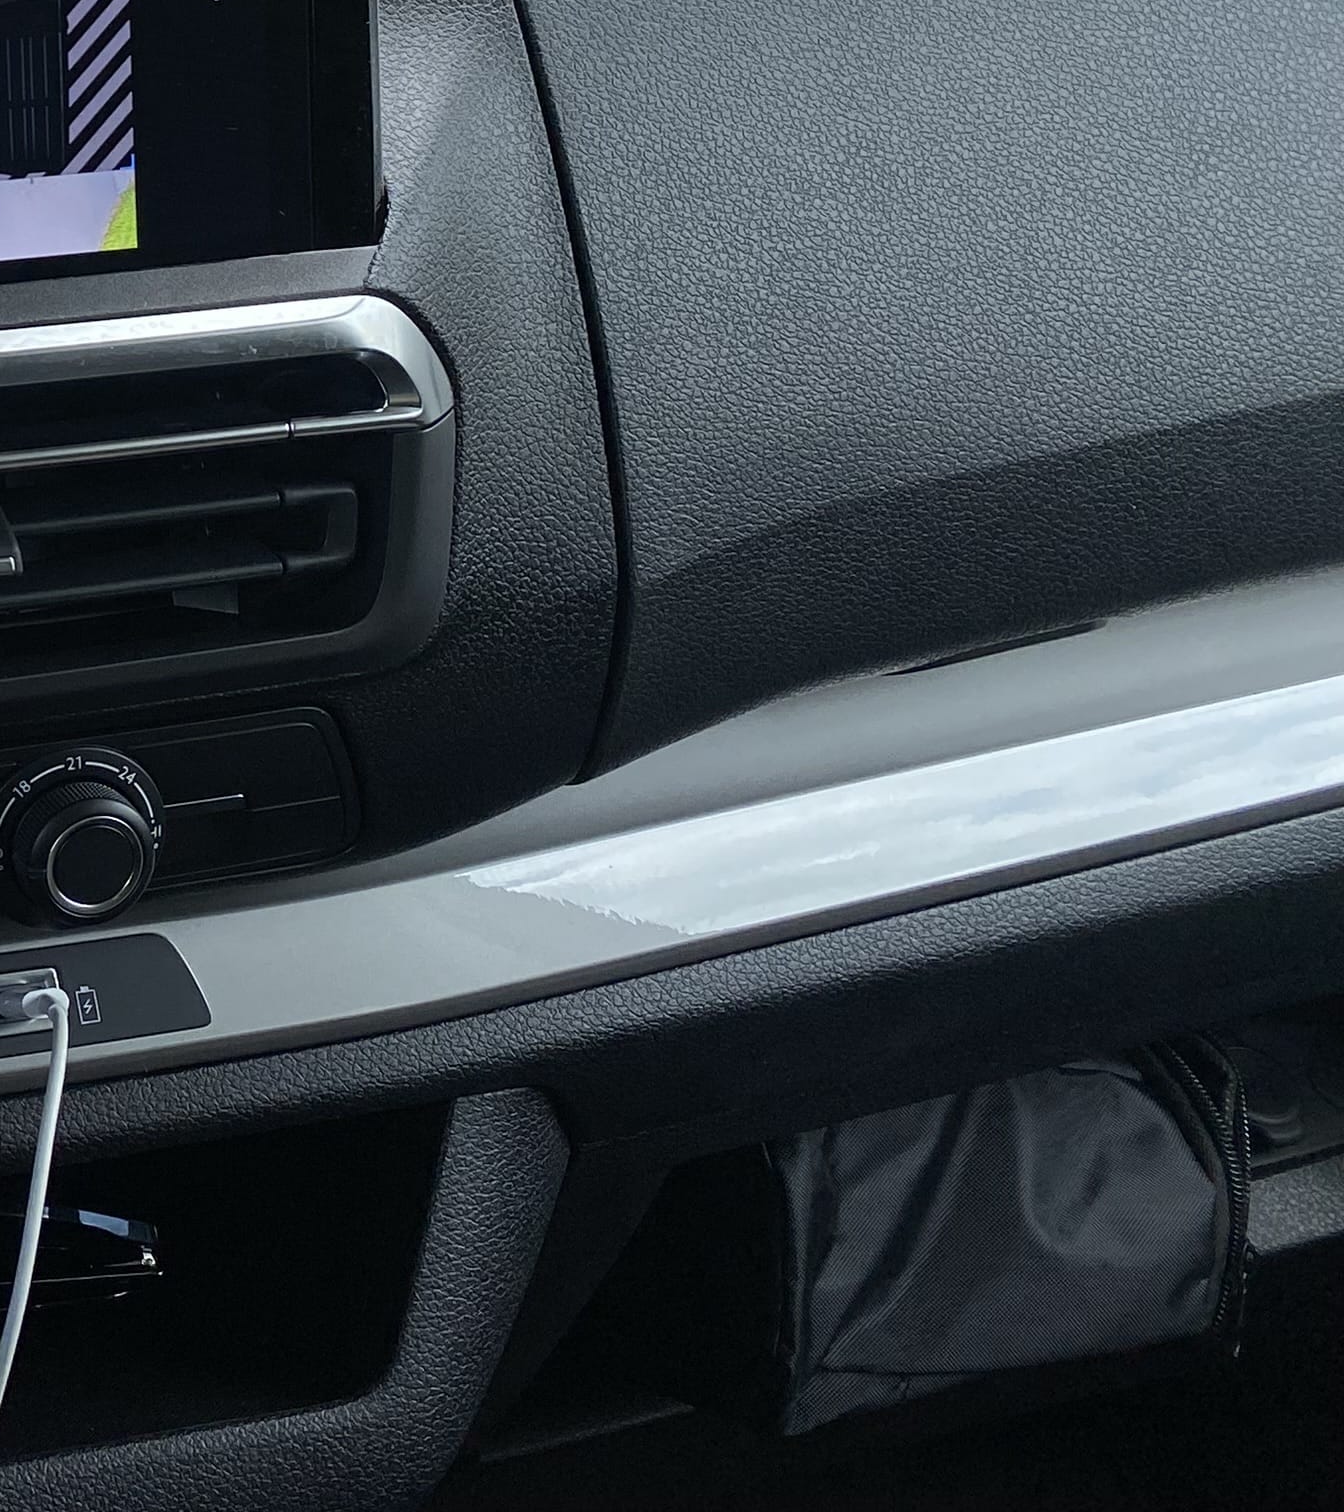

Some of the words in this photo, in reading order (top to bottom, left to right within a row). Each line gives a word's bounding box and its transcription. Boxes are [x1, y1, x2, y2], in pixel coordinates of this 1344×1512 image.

[66, 756, 82, 771] 21
[118, 766, 137, 785] 24
[12, 780, 31, 798] 18
